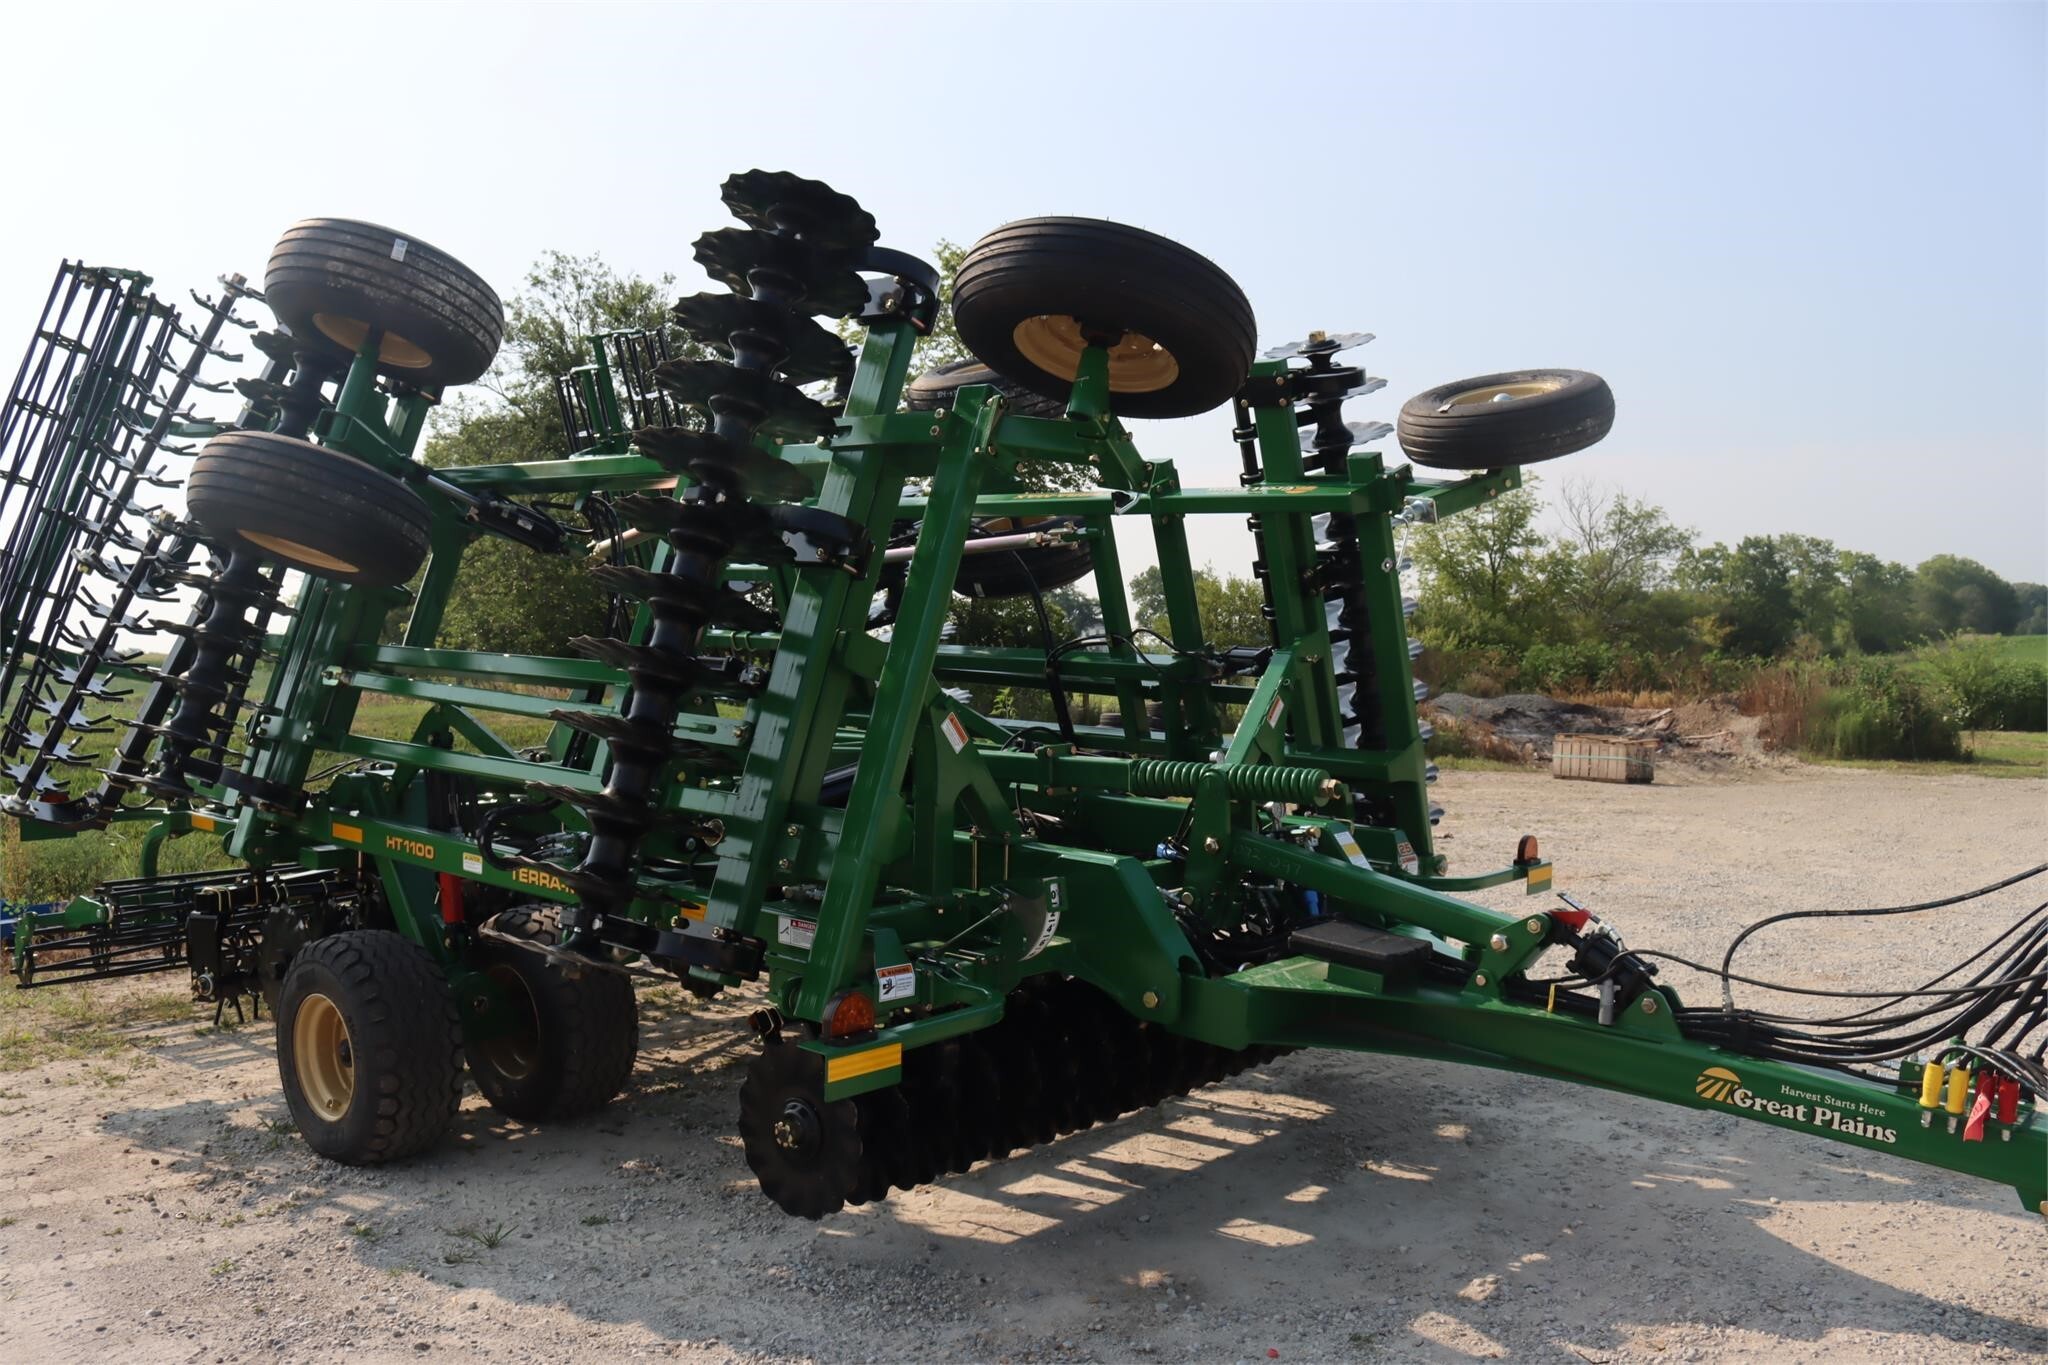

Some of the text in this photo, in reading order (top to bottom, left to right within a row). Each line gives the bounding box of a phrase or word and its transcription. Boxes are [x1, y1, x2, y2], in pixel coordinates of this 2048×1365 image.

[386, 835, 434, 859] HT1100
[1733, 1088, 1897, 1143] Great Plains
[1781, 1085, 1886, 1117] Harvest Starts Here
